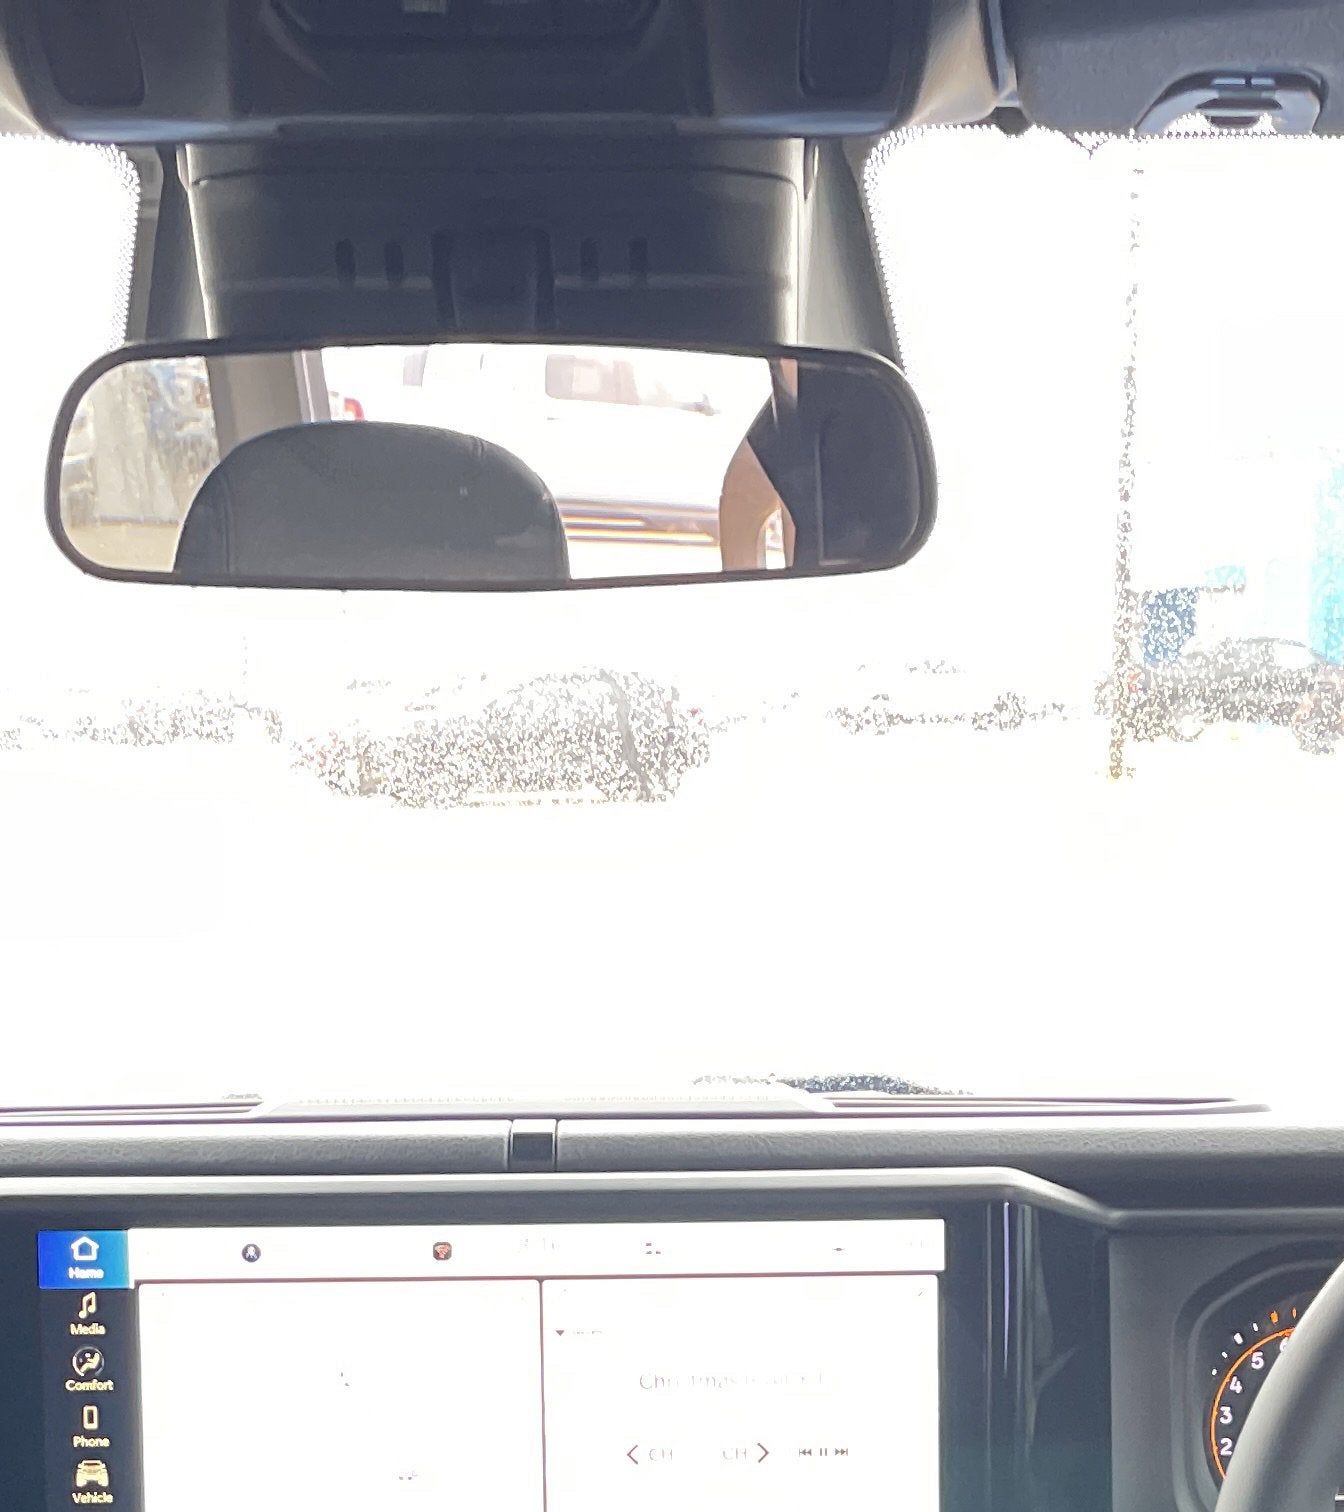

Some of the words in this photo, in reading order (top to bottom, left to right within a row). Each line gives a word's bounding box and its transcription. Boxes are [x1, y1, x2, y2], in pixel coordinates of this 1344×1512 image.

[68, 1267, 104, 1279] Home
[70, 1323, 106, 1335] Media
[1251, 1351, 1264, 1369] 5
[65, 1379, 114, 1391] Comfort
[1229, 1376, 1243, 1393] 4
[1219, 1406, 1233, 1424] 3
[72, 1435, 110, 1447] Phone
[1220, 1438, 1233, 1456] 2
[71, 1491, 113, 1503] Vehicle
